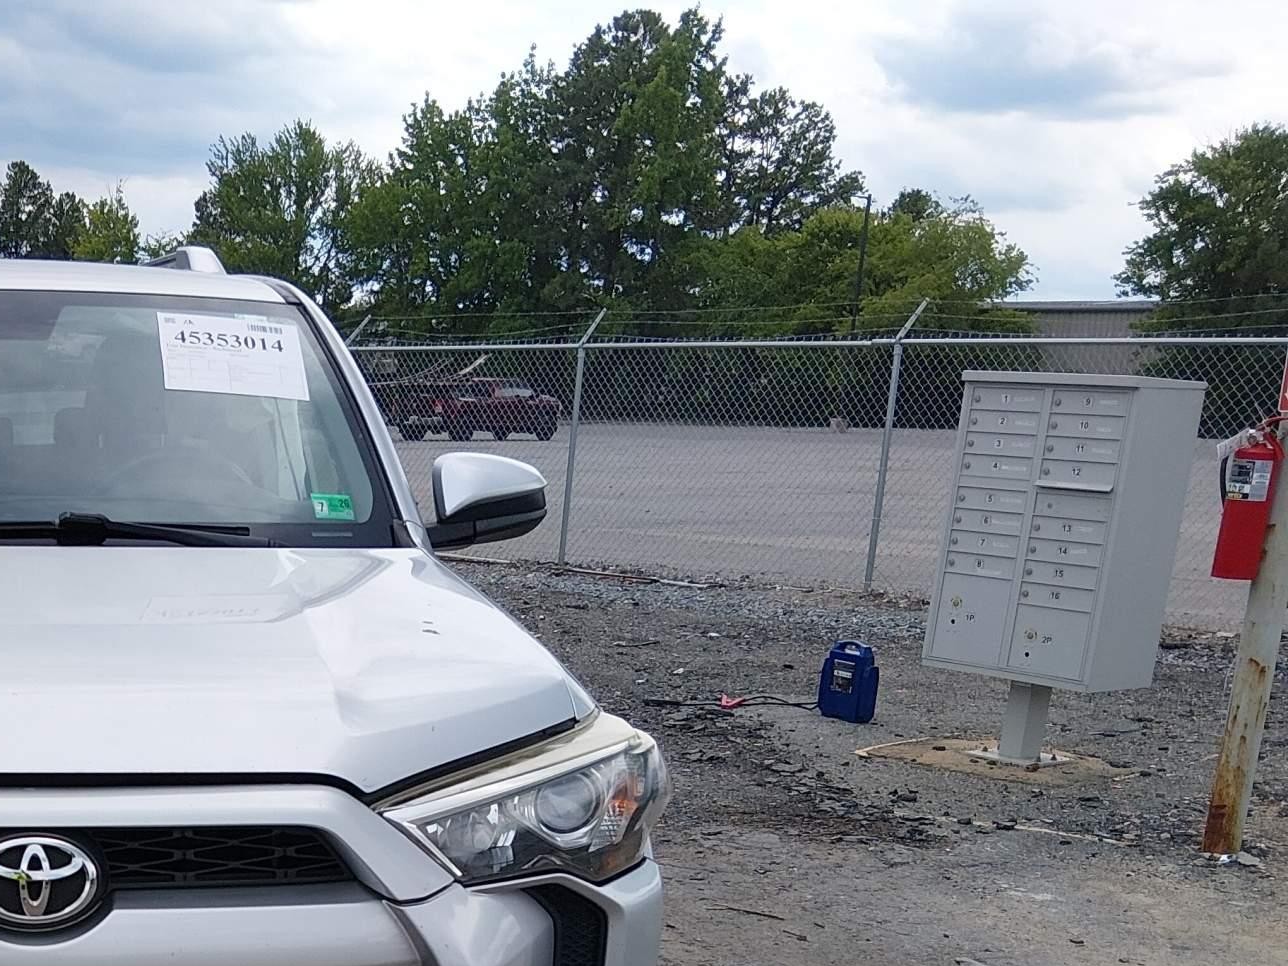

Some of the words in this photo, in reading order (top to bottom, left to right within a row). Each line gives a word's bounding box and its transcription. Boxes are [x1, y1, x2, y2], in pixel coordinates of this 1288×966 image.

[174, 329, 284, 353] 45353014
[1079, 421, 1089, 430] 10
[1075, 444, 1085, 453] 11
[1072, 467, 1081, 476] 12
[317, 501, 324, 513] 7
[1062, 524, 1072, 533] 13
[1058, 546, 1068, 555] 14
[1054, 569, 1064, 578] 15
[1050, 591, 1061, 600] 16
[965, 613, 975, 622] 1P
[1041, 635, 1053, 645] 2P
